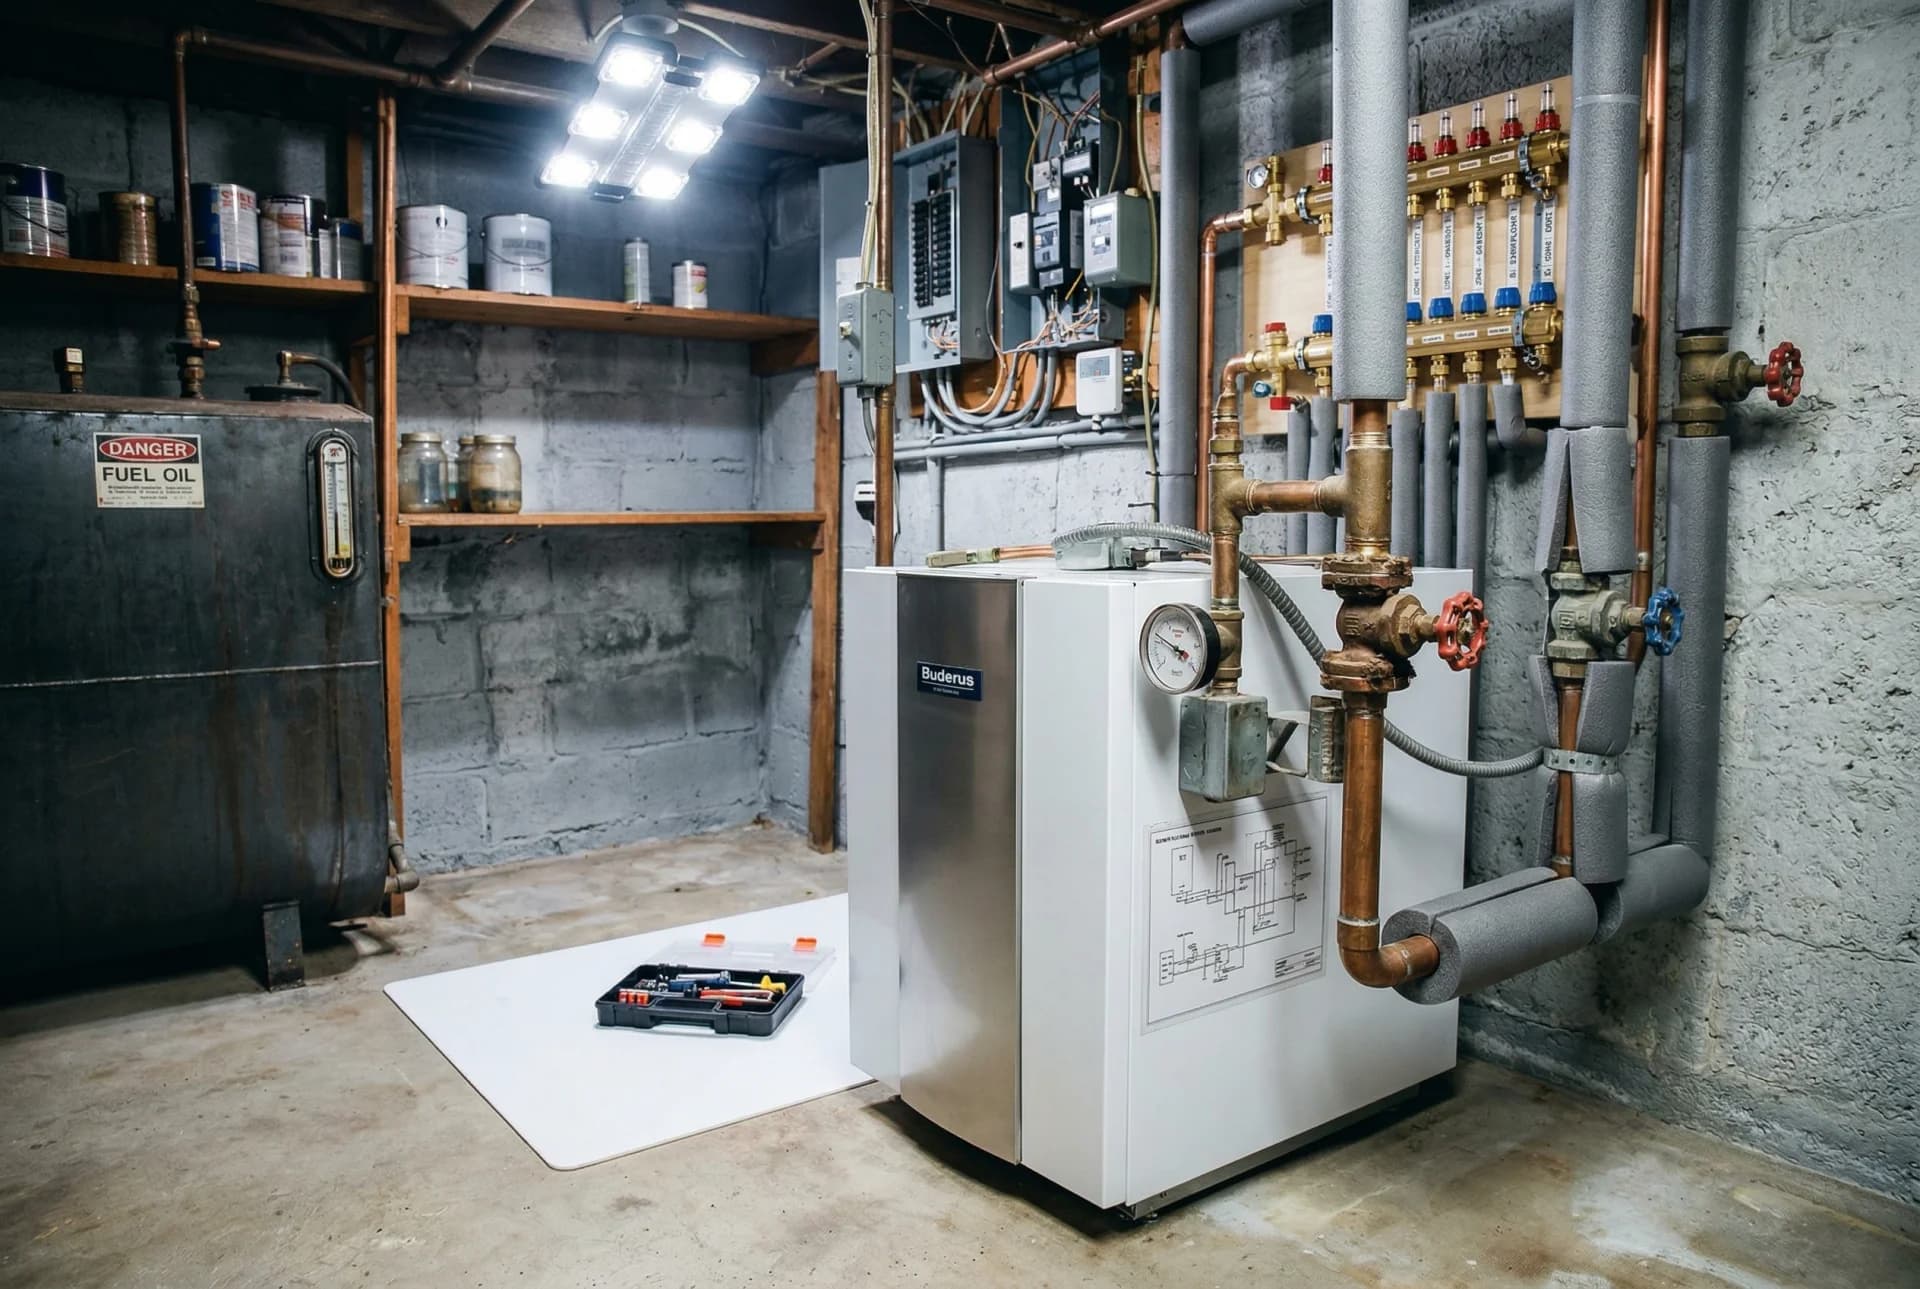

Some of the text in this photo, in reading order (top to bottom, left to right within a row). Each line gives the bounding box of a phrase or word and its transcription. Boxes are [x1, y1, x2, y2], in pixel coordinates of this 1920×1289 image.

[109, 442, 187, 457] DANGER
[103, 467, 196, 482] FUEL OIL
[921, 666, 975, 687] Buderus
